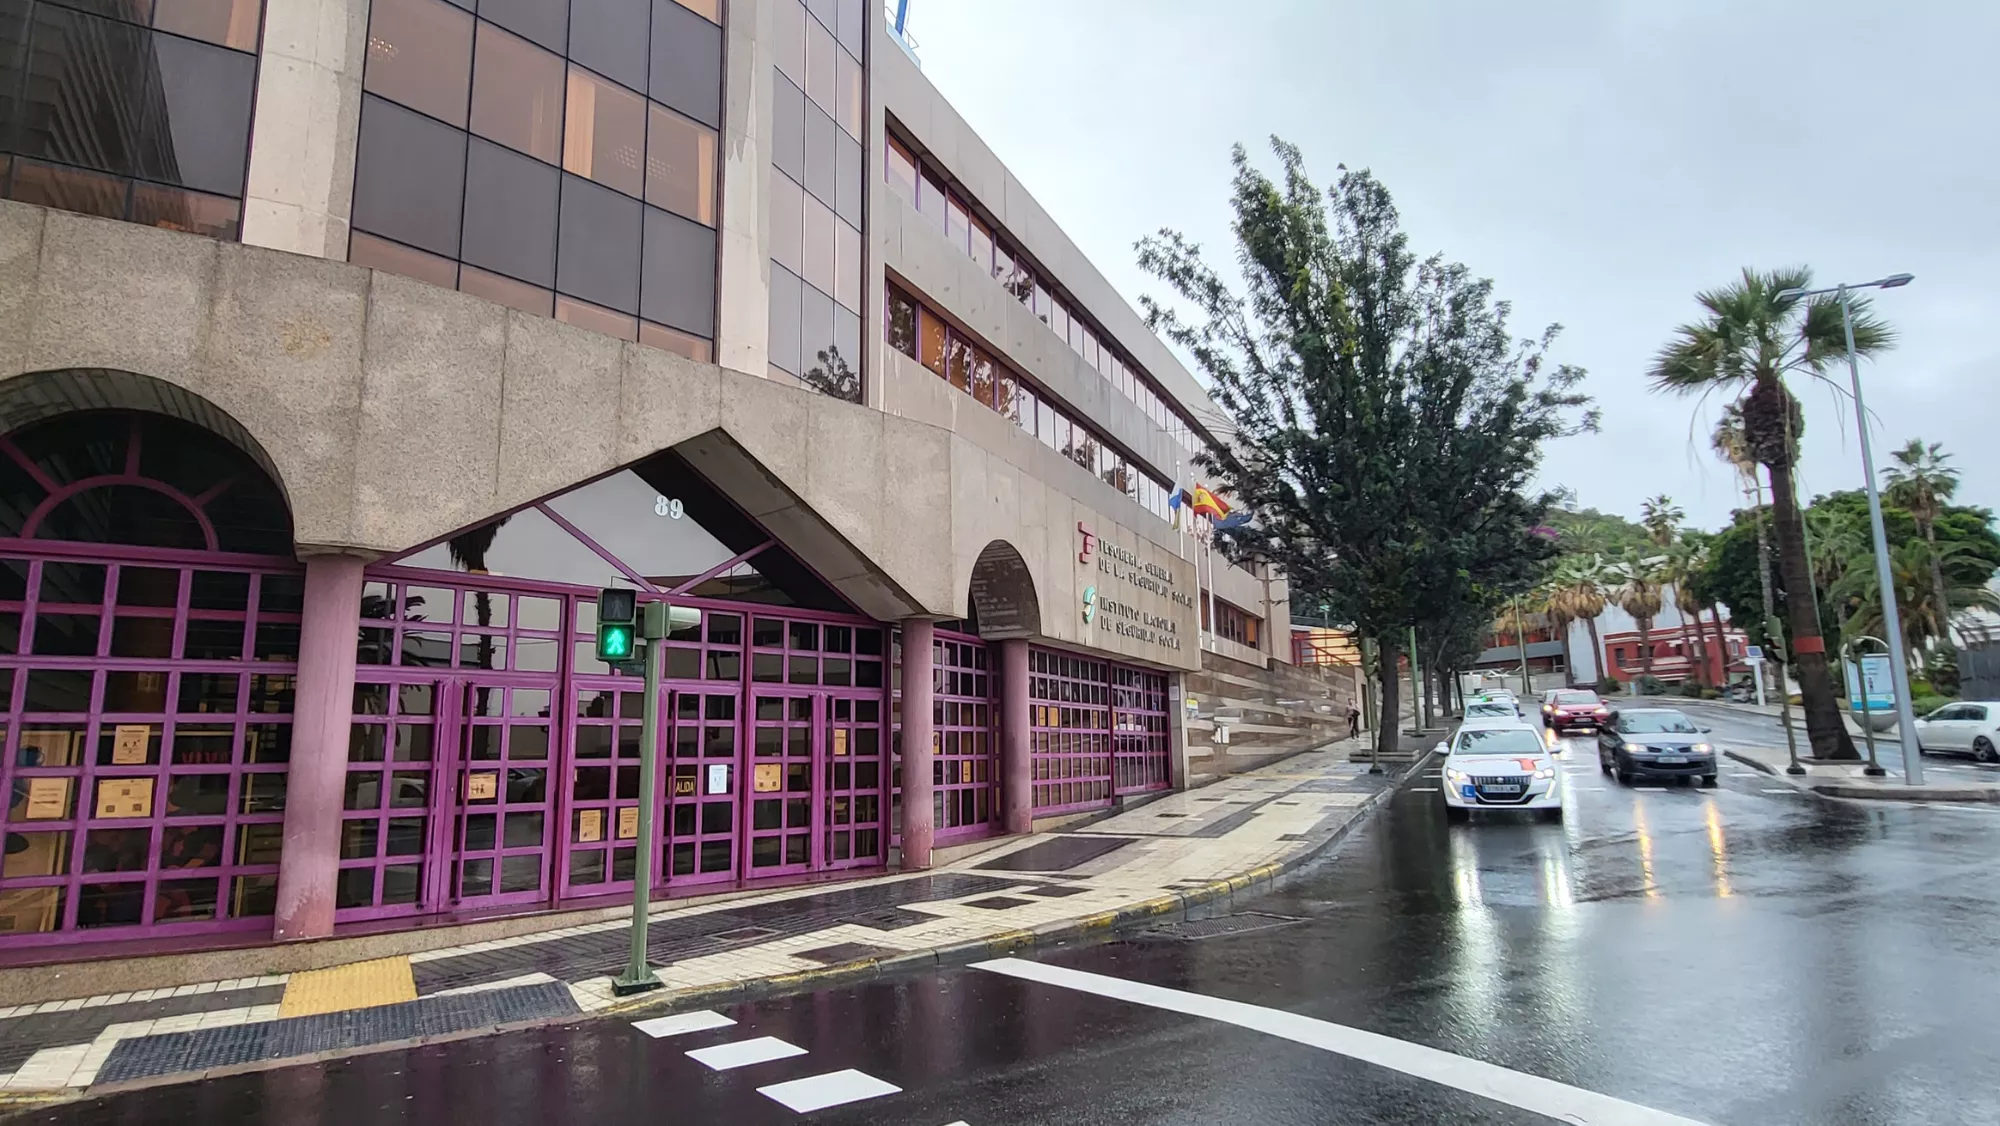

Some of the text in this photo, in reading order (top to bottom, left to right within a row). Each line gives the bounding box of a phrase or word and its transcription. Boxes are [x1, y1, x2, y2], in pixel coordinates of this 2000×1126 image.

[654, 494, 684, 520] 89
[1099, 557, 1193, 609] DE LA SEGURIDAD SOCIAL
[1100, 597, 1176, 634] INSTITUTO NACIONAL
[1101, 615, 1180, 651] DE SEGURIDAD SOCIAL
[674, 780, 694, 793] ALIDA
